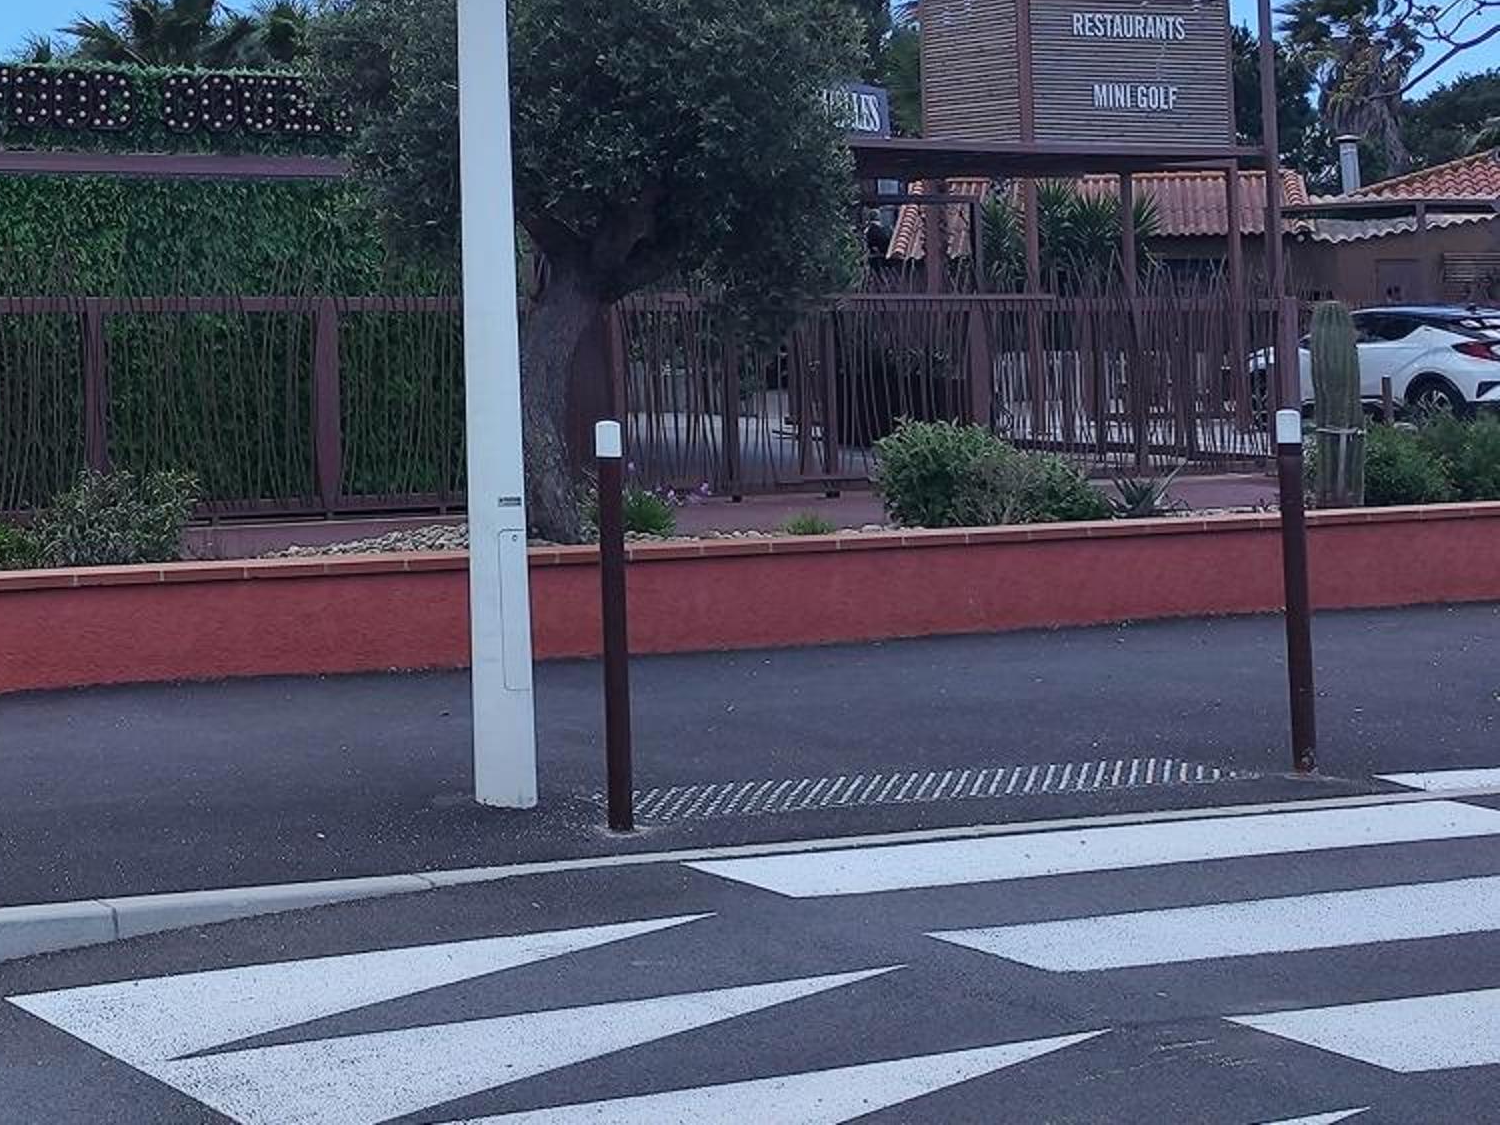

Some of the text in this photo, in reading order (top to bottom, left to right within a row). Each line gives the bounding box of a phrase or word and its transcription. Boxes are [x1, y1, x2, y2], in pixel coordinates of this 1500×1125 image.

[1072, 12, 1186, 40] RESTAURANTS
[1093, 83, 1178, 110] MINI GOLF
